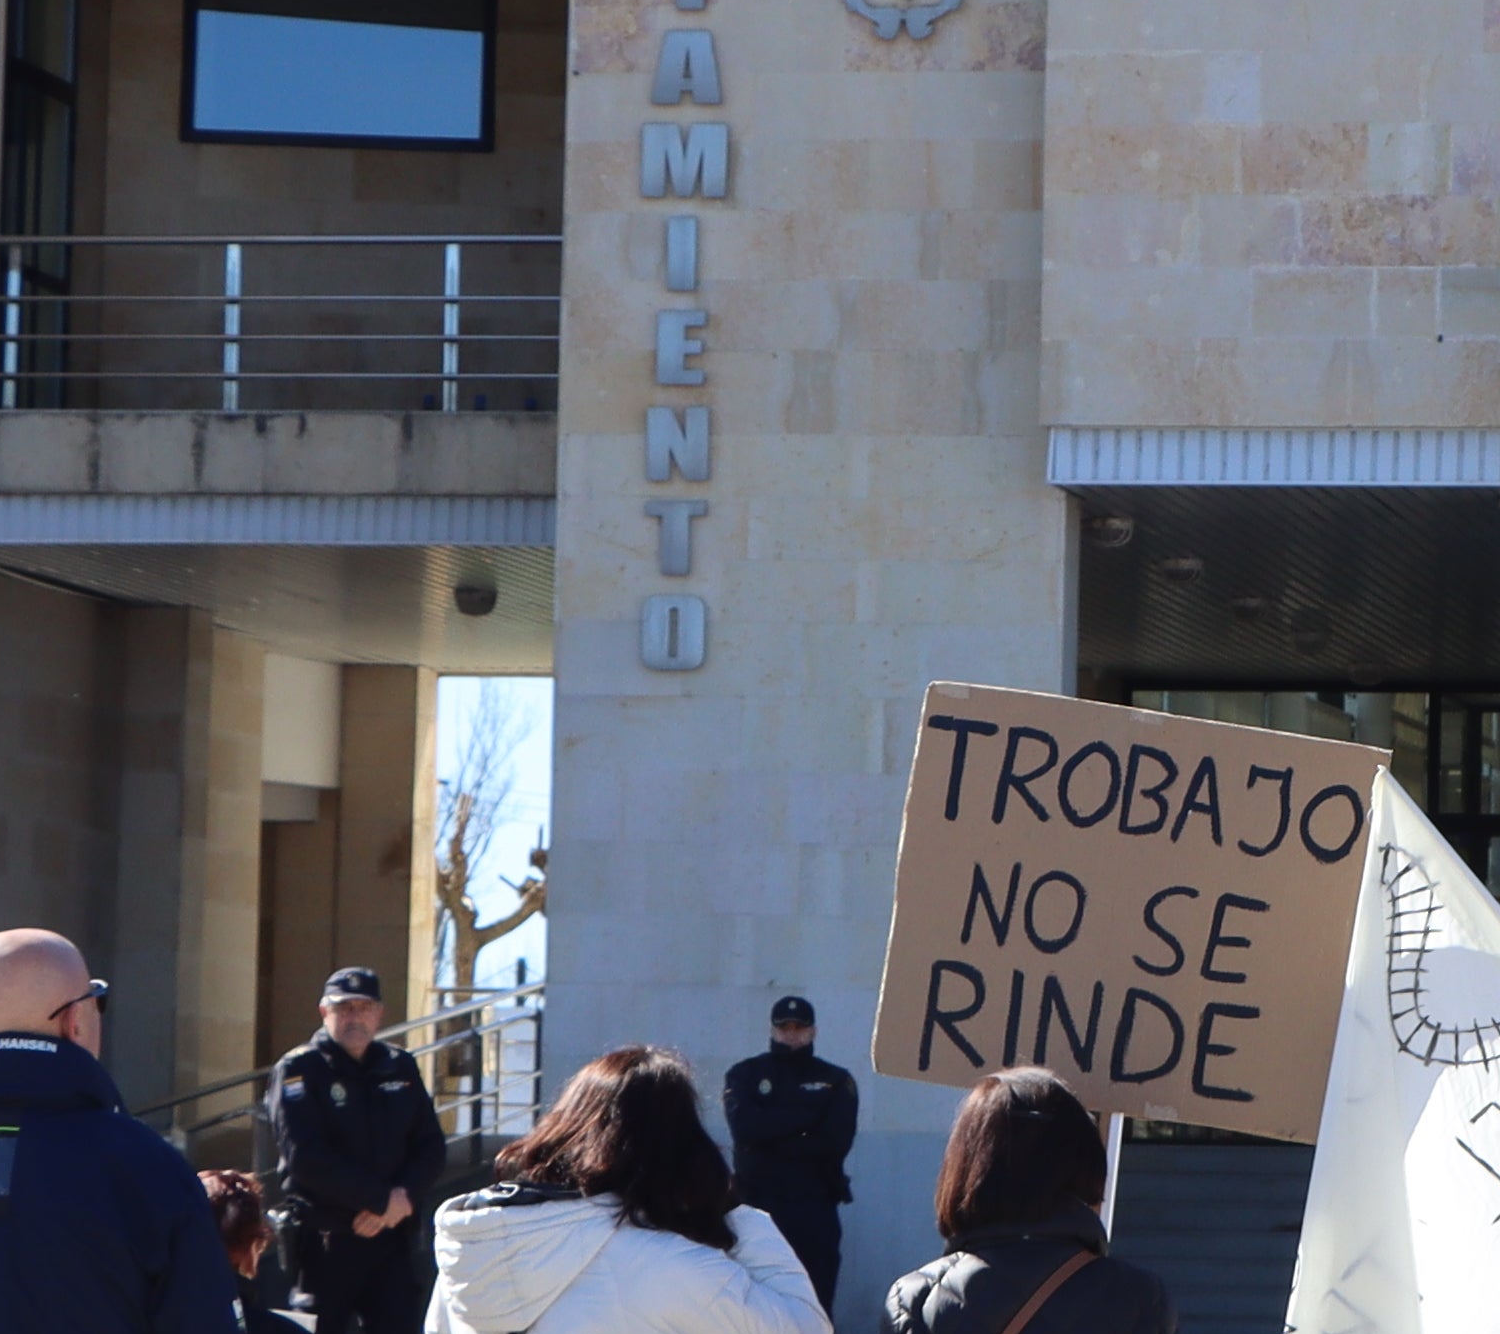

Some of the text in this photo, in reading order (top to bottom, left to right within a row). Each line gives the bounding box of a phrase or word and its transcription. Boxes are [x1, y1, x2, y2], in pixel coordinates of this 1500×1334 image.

[927, 714, 1364, 863] TROBAJO
[960, 862, 1272, 985] NO SE
[916, 958, 1262, 1104] RINDE
